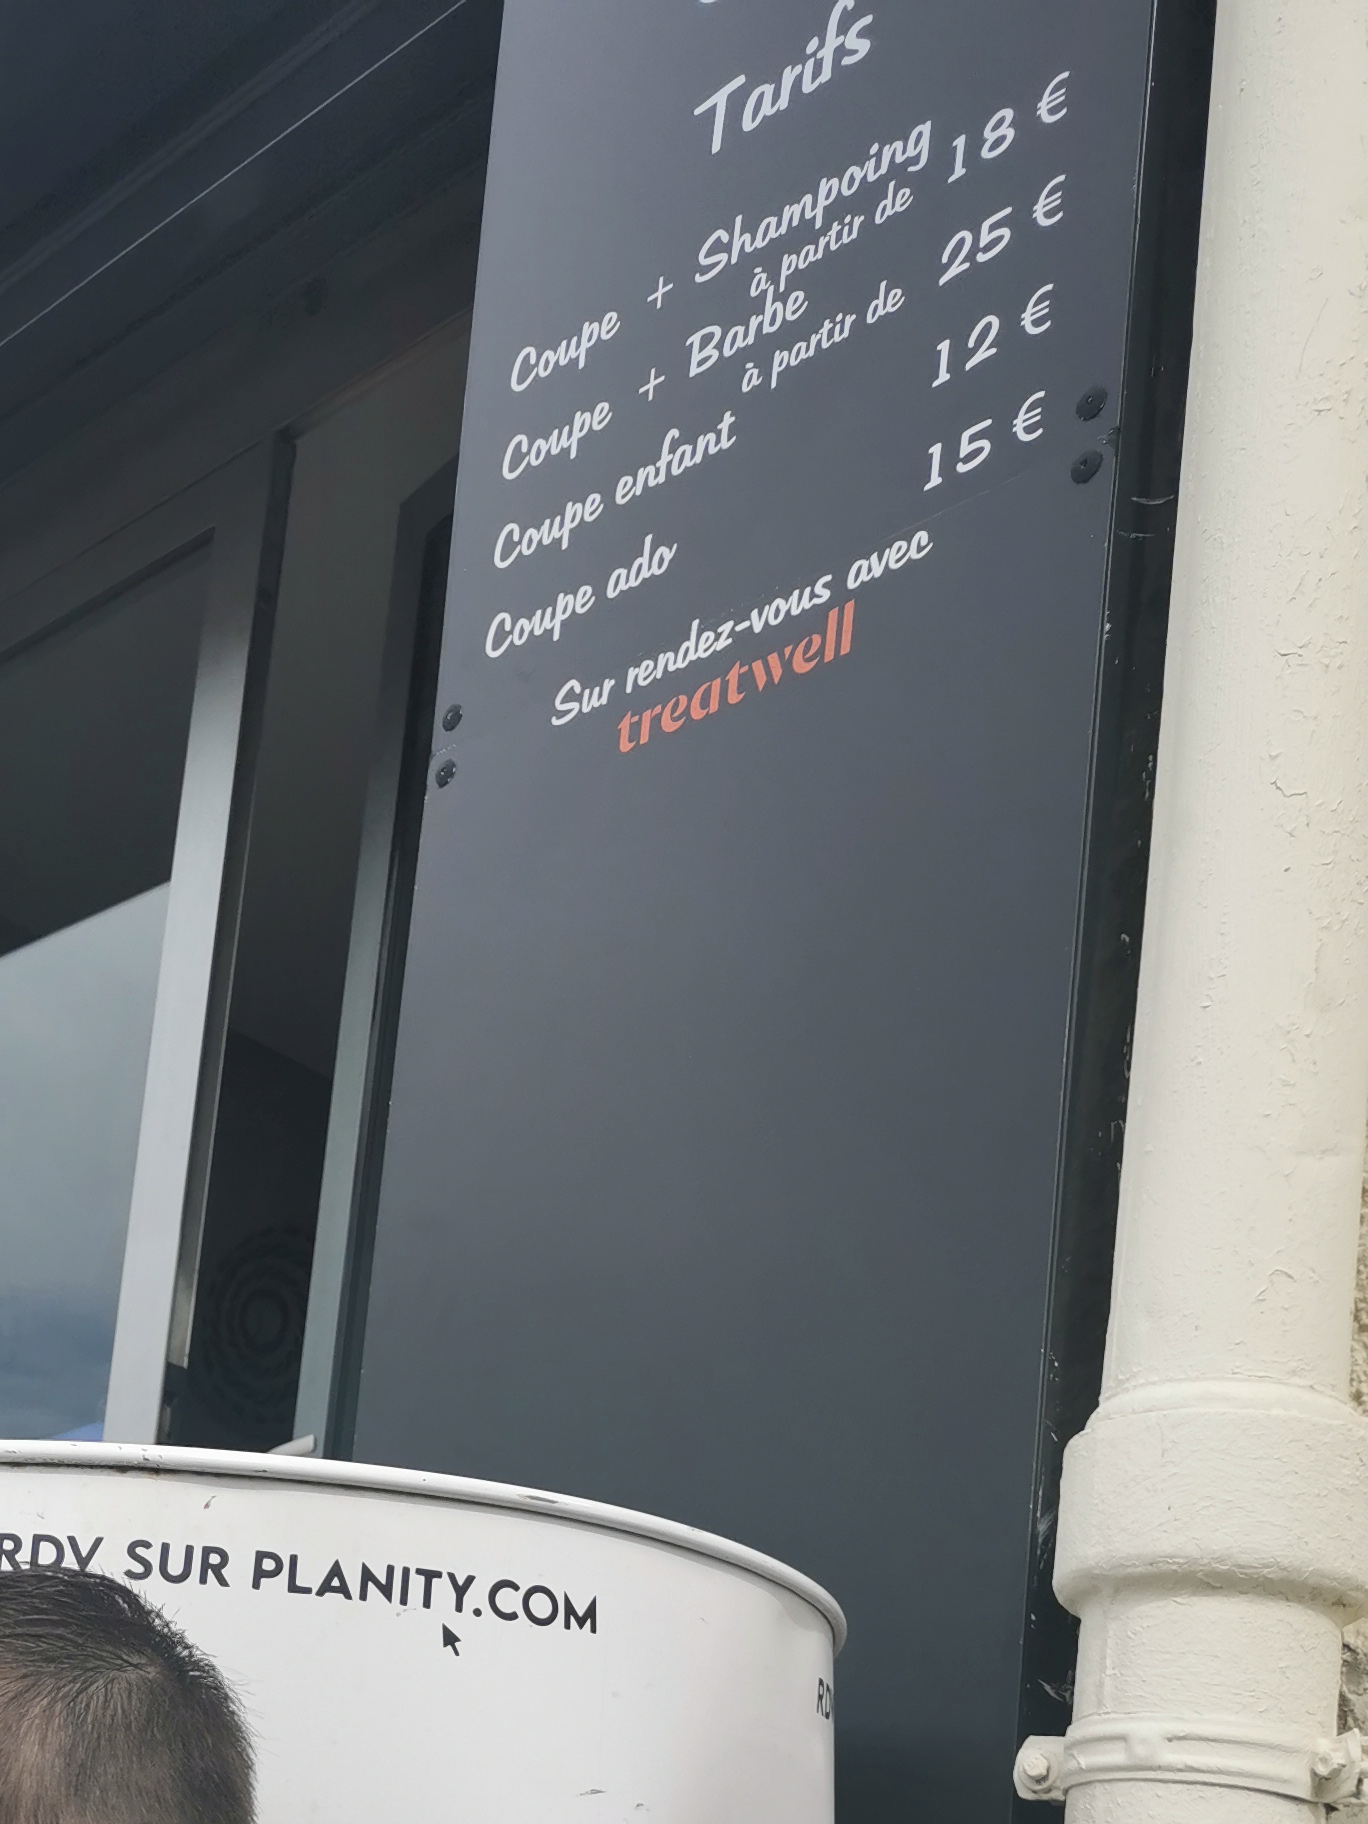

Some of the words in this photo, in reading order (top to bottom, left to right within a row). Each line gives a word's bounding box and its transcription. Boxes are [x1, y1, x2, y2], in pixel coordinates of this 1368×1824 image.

[694, 0, 873, 155] Tarifs
[510, 311, 621, 392] Coupe
[646, 275, 674, 310] +
[694, 119, 932, 284] Shampoing
[741, 362, 764, 393] à
[770, 312, 857, 390] partir
[866, 279, 906, 324] de
[938, 206, 1013, 287] 25
[1031, 174, 1067, 227] €
[749, 266, 771, 297] à
[778, 214, 865, 294] partir
[874, 178, 914, 225] de
[947, 107, 1016, 184] 18
[1035, 70, 1071, 124] €
[493, 492, 604, 569] Coupe
[614, 410, 737, 505] enfant
[931, 314, 1000, 389] 12
[1019, 283, 1055, 335] €
[501, 401, 613, 481] Coupe
[638, 367, 666, 402] +
[685, 283, 808, 379] Barbe
[485, 584, 596, 659] Coupe
[606, 533, 678, 599] ado
[923, 418, 993, 492] 15
[1011, 390, 1046, 442] €
[550, 678, 616, 726] Sur
[625, 573, 833, 694] rendez-vous
[846, 530, 934, 590] avec
[617, 598, 855, 753] treatwell
[124, 1539, 230, 1588] SUR
[251, 1549, 597, 1634] PLANITY.COM
